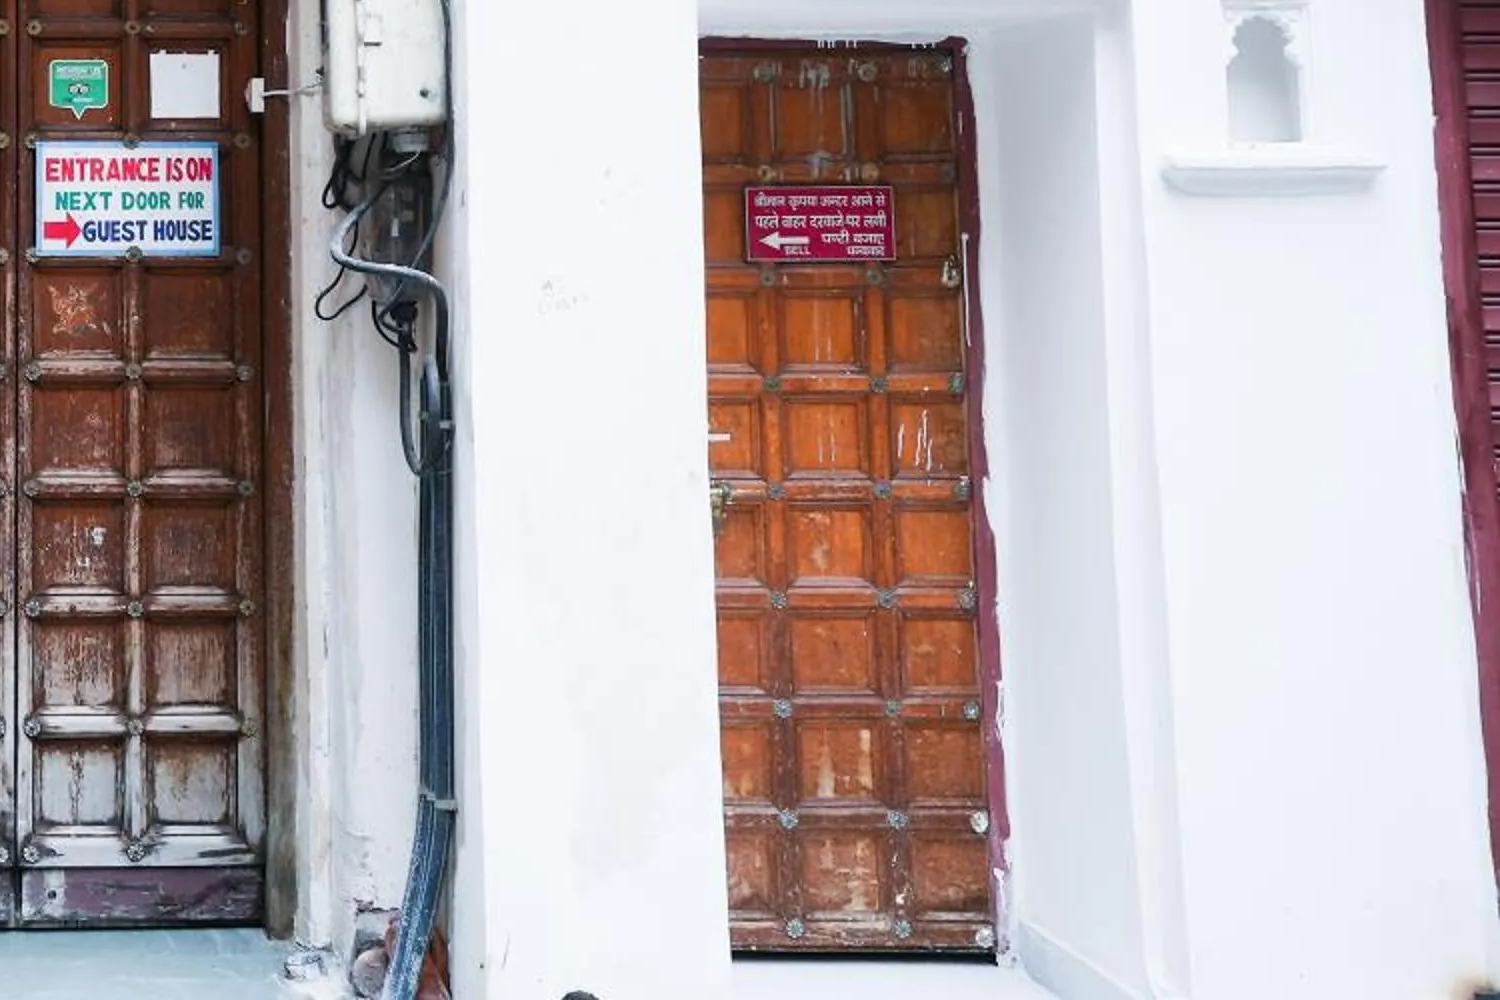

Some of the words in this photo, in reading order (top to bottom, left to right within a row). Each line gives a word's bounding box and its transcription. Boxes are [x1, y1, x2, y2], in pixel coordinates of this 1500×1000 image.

[45, 157, 160, 183] ENTRANCE
[166, 157, 183, 182] IS
[186, 157, 212, 182] ON
[55, 191, 113, 211] NEXT
[121, 191, 171, 210] DOOR
[179, 191, 205, 210] FOR
[83, 220, 148, 243] GUEST
[153, 220, 213, 242] HOUSE
